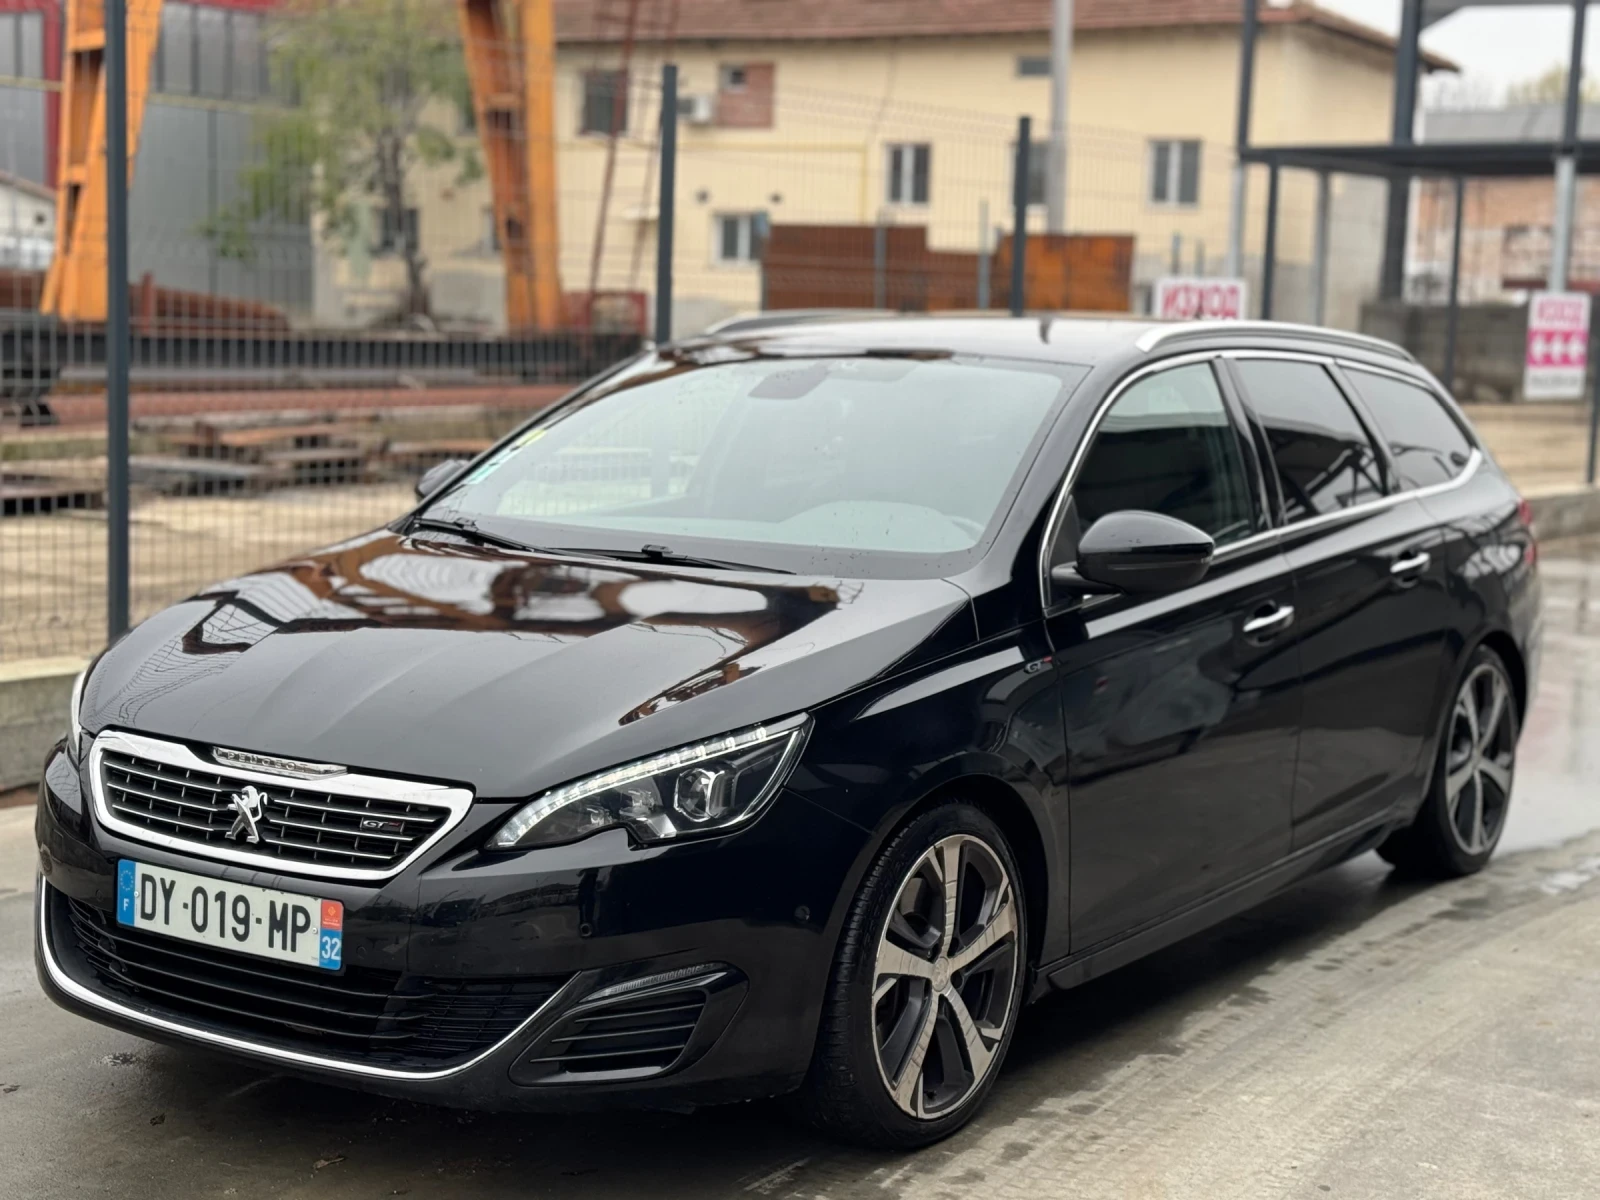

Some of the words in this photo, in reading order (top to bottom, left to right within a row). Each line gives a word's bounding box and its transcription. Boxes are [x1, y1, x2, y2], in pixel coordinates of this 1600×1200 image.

[227, 751, 309, 773] PEUGEOT
[363, 820, 388, 829] GT
[123, 898, 130, 911] F
[321, 935, 341, 961] 32
